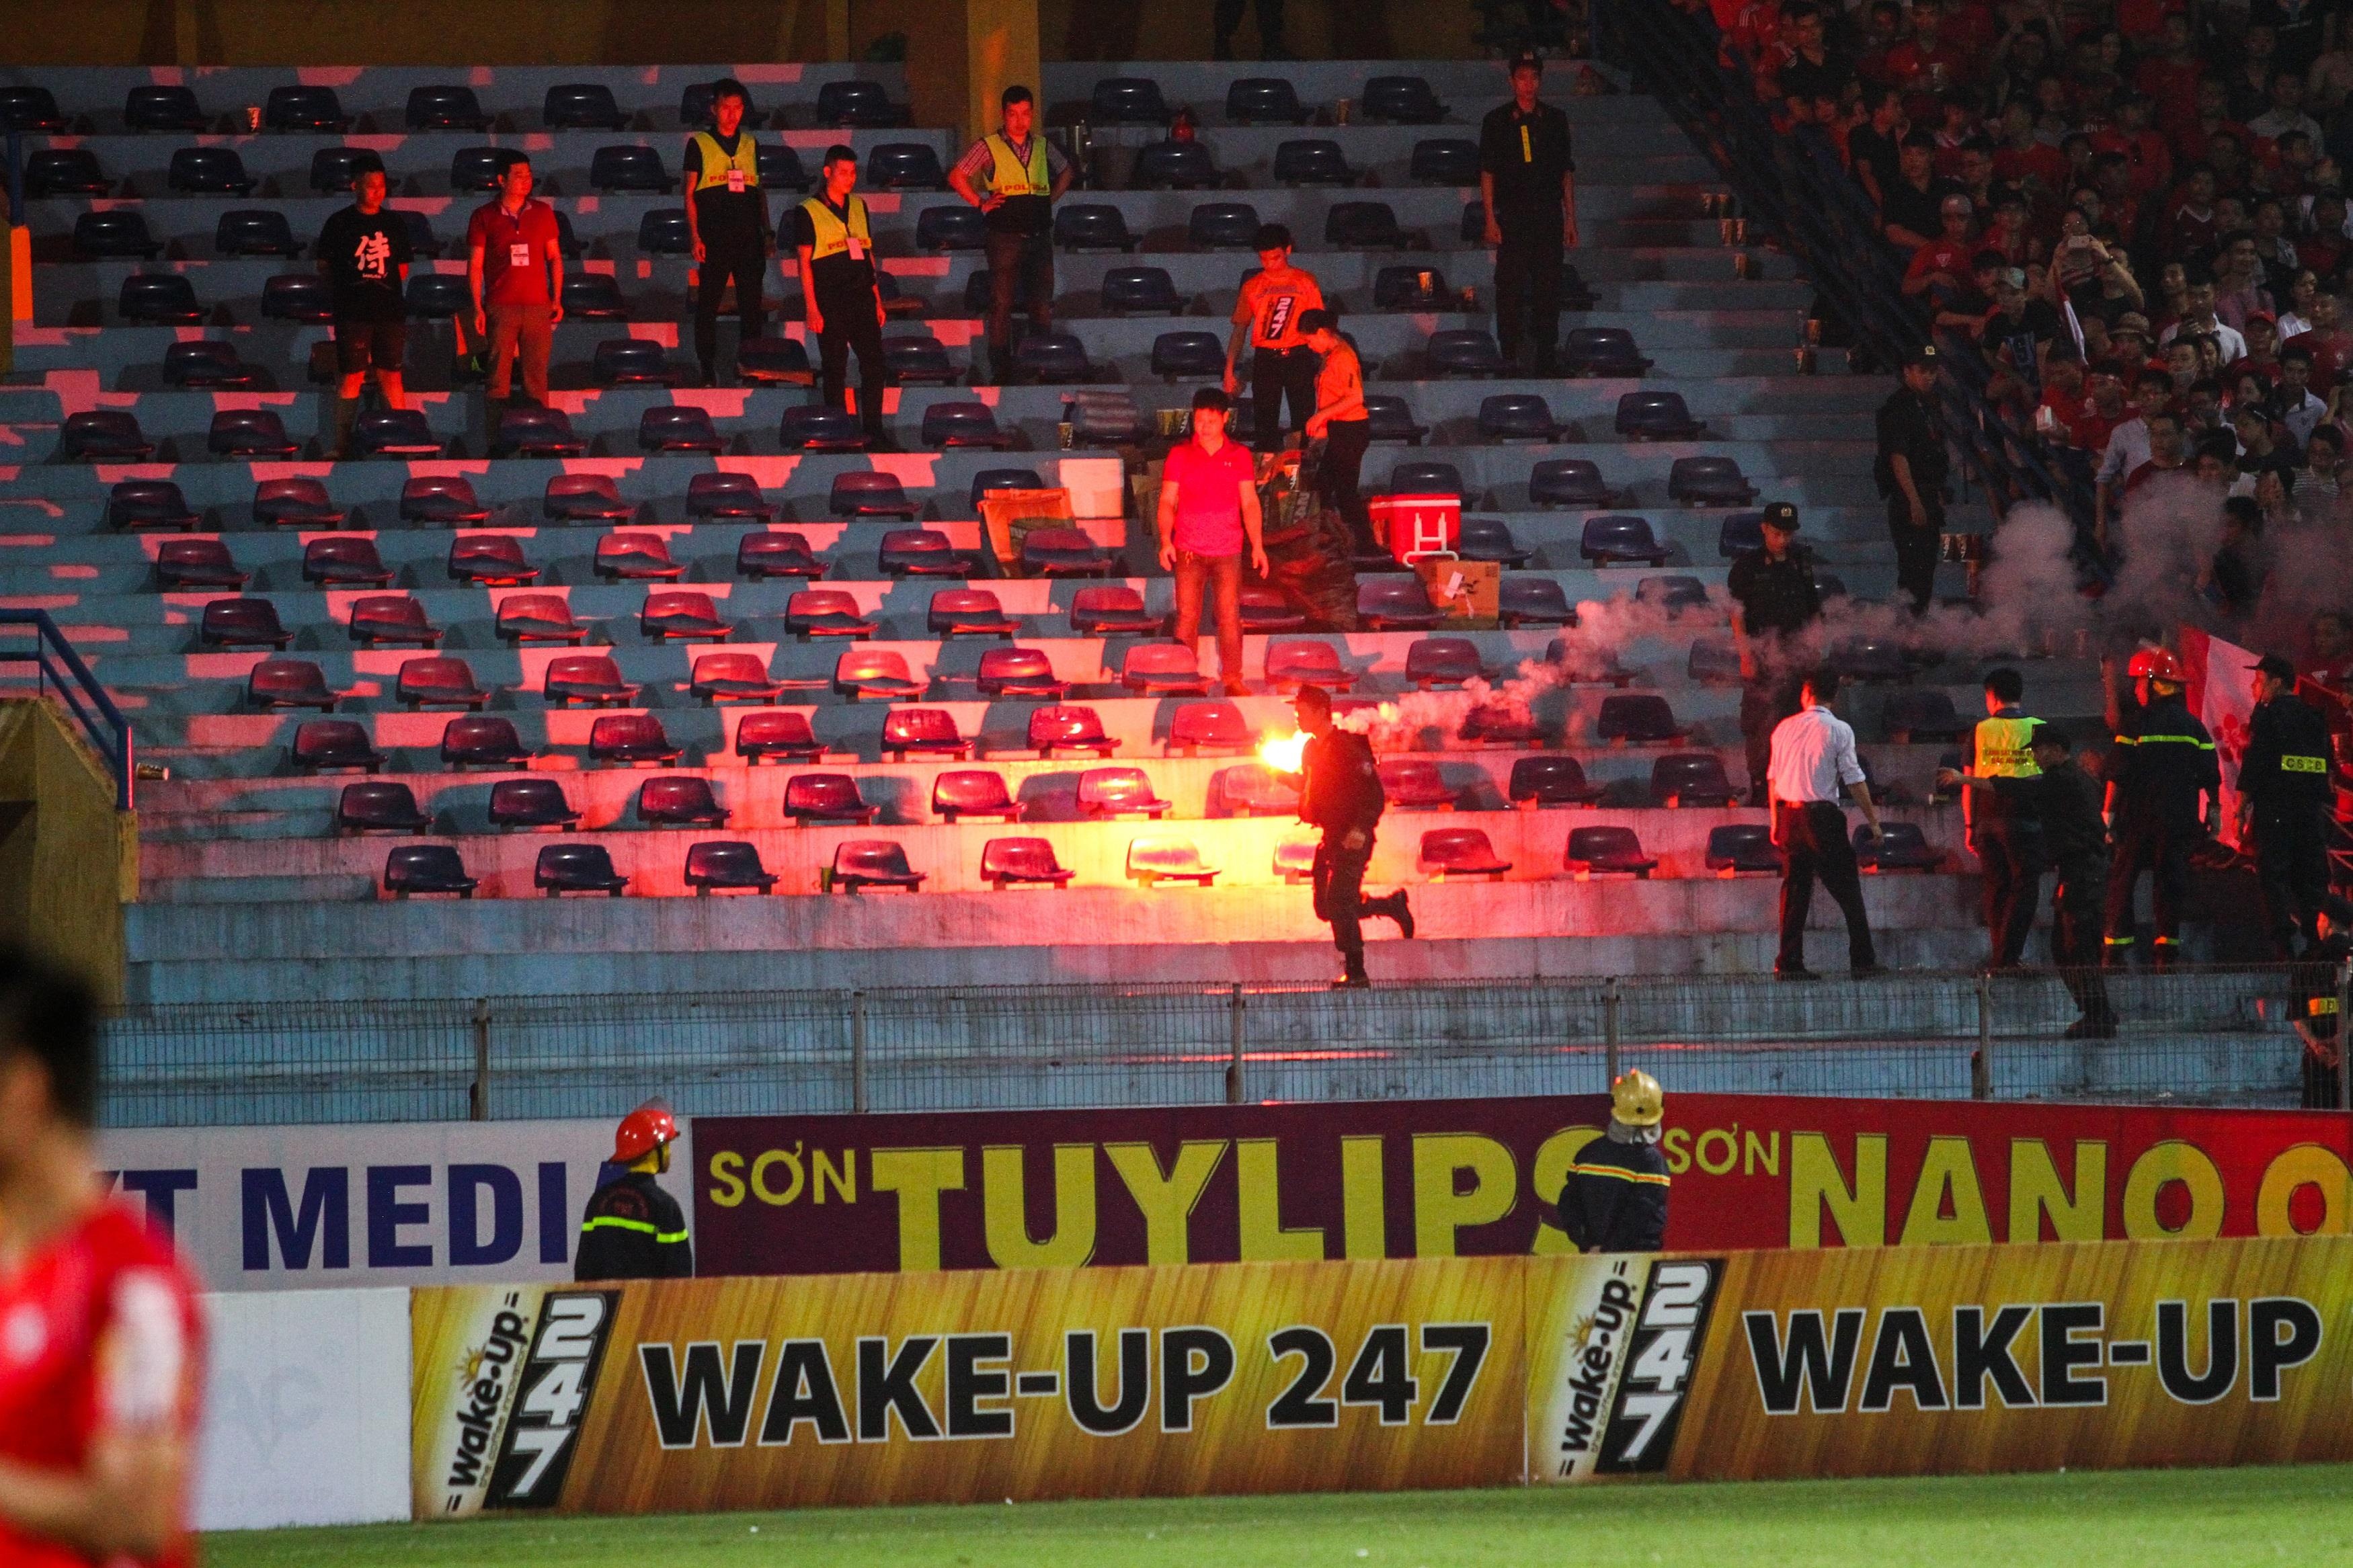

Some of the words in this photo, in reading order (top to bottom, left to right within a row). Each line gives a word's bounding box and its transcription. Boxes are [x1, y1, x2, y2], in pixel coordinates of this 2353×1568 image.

[709, 175, 756, 183] POCE
[354, 231, 391, 275] 侍
[1270, 297, 1291, 337] 247
[241, 1161, 630, 1271] MEDI
[709, 1141, 856, 1206] SƠN
[1663, 1122, 1780, 1177] SƠN
[1789, 1131, 2226, 1251] NANO
[508, 1293, 606, 1498] 247
[638, 1325, 1236, 1449] WAKE-UP
[1266, 1322, 1492, 1430] 247
[1618, 1261, 1712, 1462] 247
[1741, 1296, 2323, 1415] WAKE-UP
